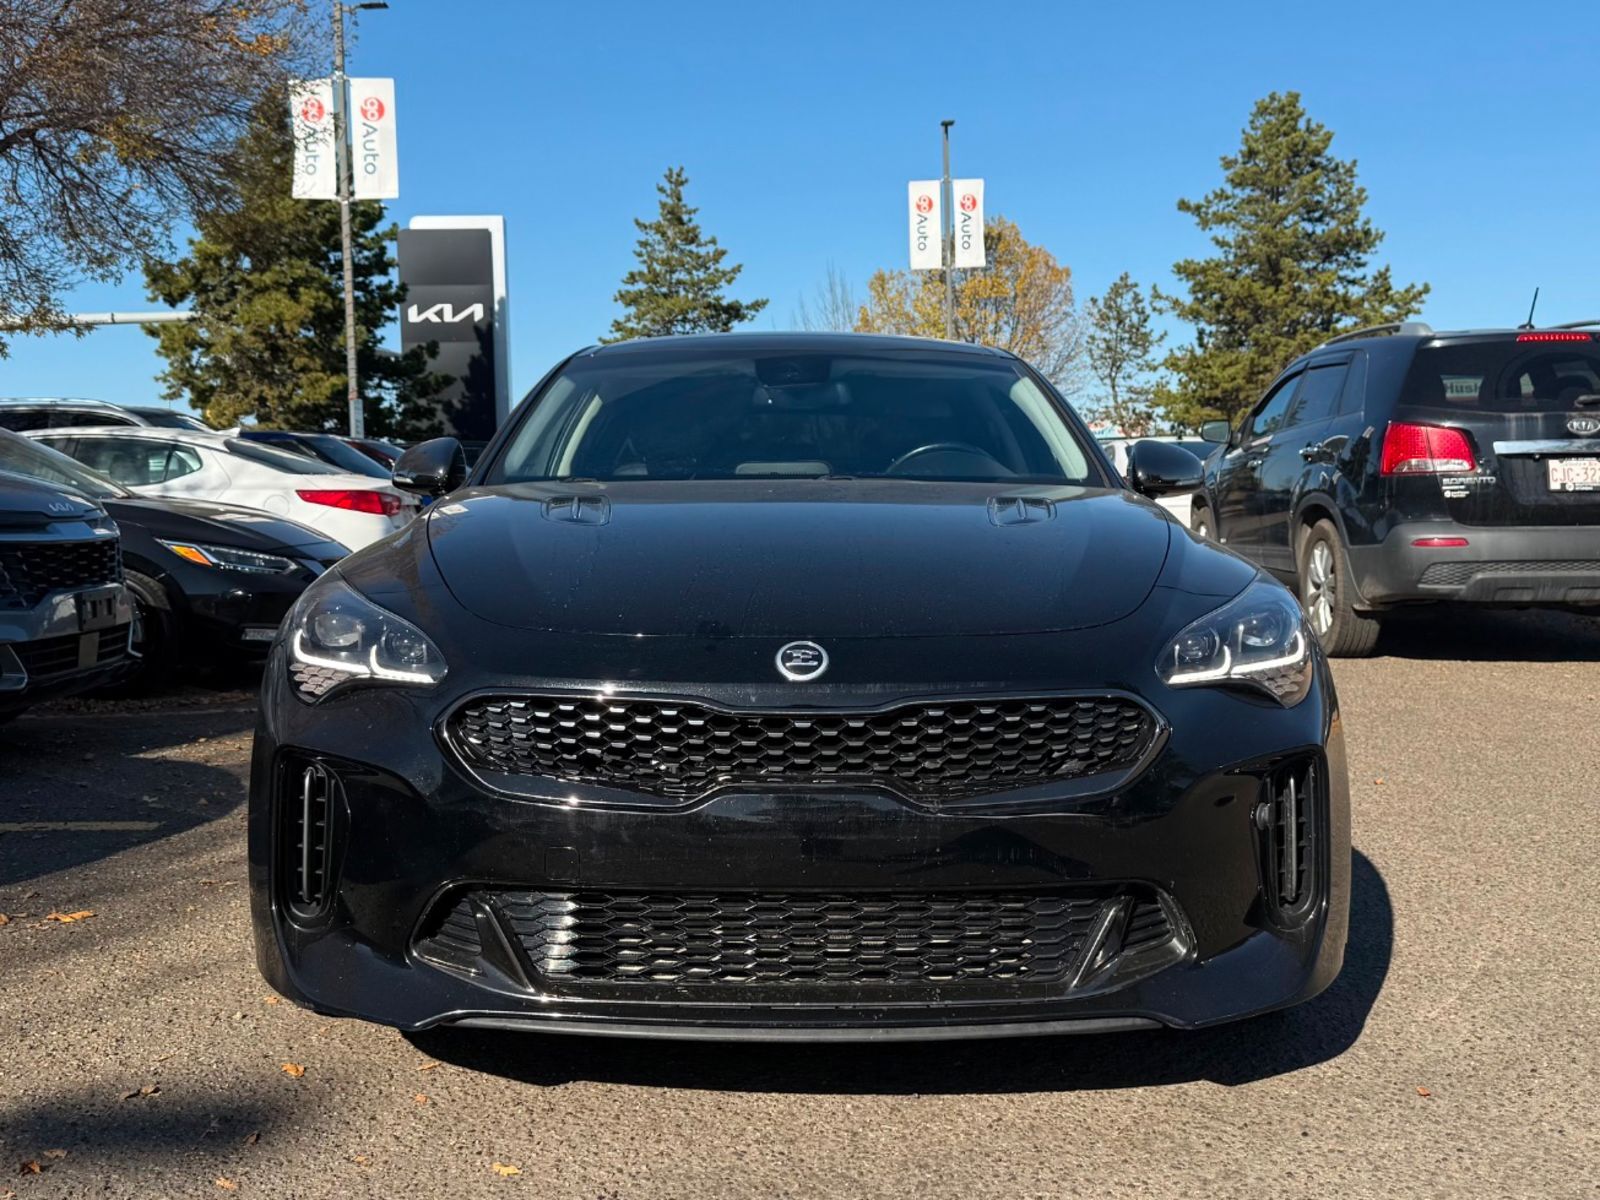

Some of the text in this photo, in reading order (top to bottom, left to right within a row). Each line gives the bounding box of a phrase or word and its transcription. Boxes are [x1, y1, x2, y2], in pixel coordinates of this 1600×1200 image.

[304, 121, 319, 175] Auto
[362, 122, 379, 175] Auto
[916, 213, 929, 251] Auto
[960, 212, 972, 250] Auto
[408, 303, 484, 323] KIA
[1572, 420, 1595, 431] KIA
[1442, 476, 1496, 485] SORENTO
[1551, 467, 1600, 482] CJC-32
